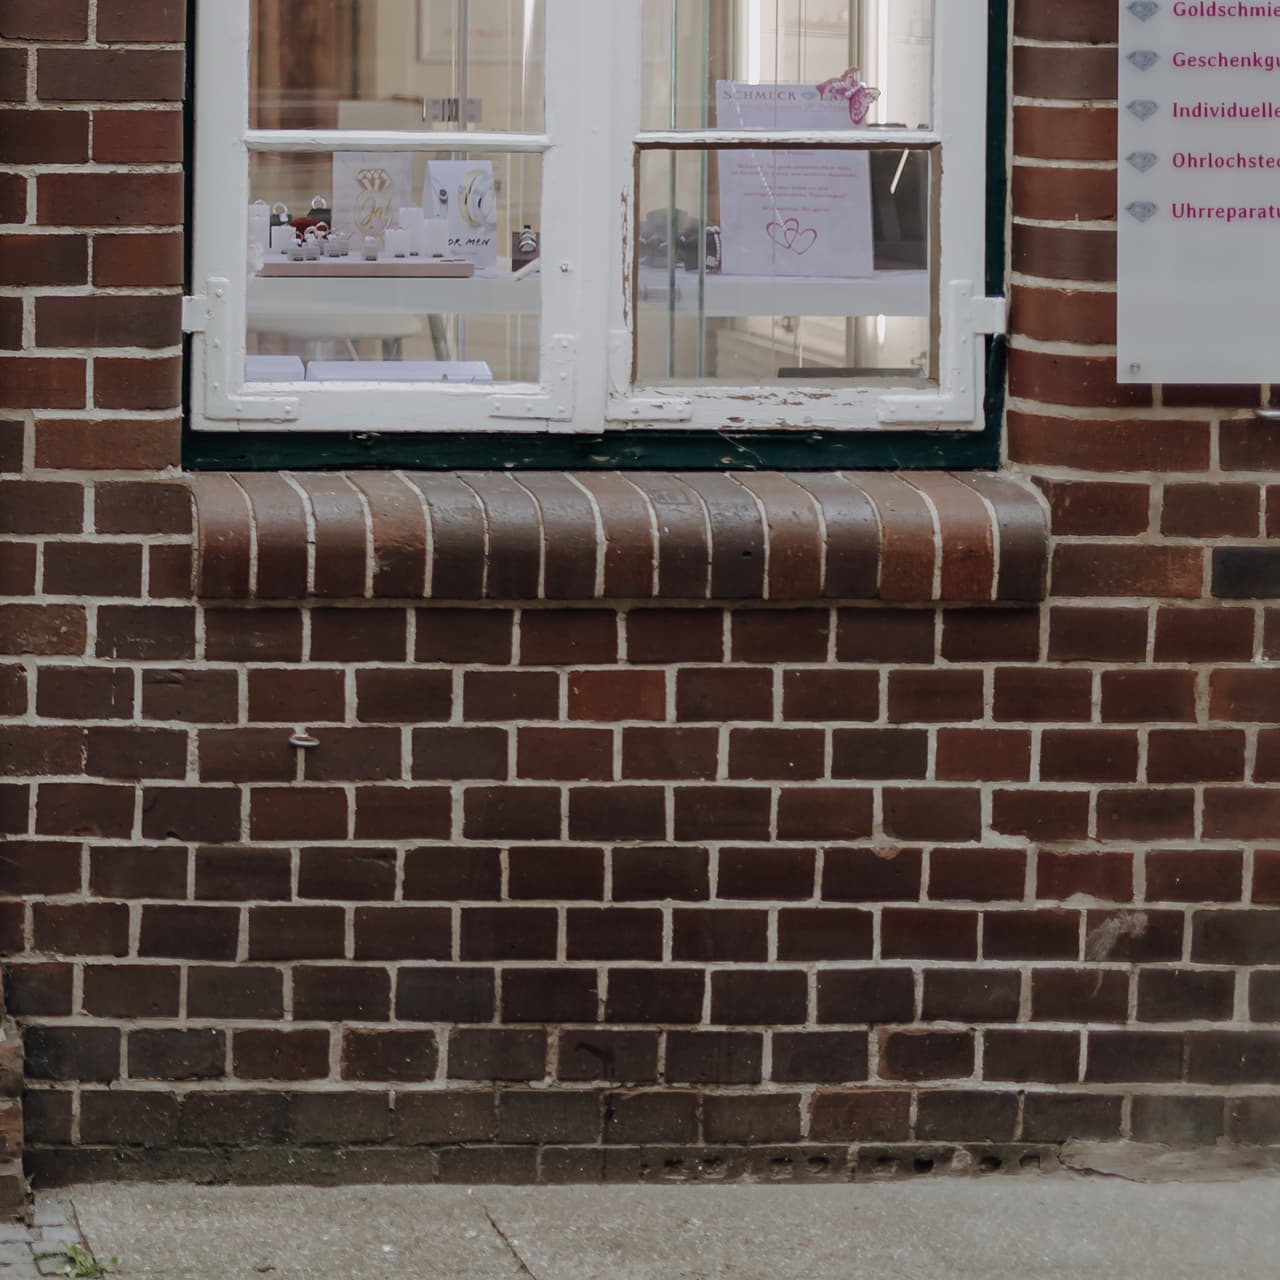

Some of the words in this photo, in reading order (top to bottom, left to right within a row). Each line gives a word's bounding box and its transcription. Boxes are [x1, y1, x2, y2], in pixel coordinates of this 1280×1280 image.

[1173, 1, 1280, 18] Goldschmie
[1172, 102, 1280, 118] Individuelle
[1172, 152, 1280, 168] Ohrlochstec
[465, 238, 491, 247] MEN
